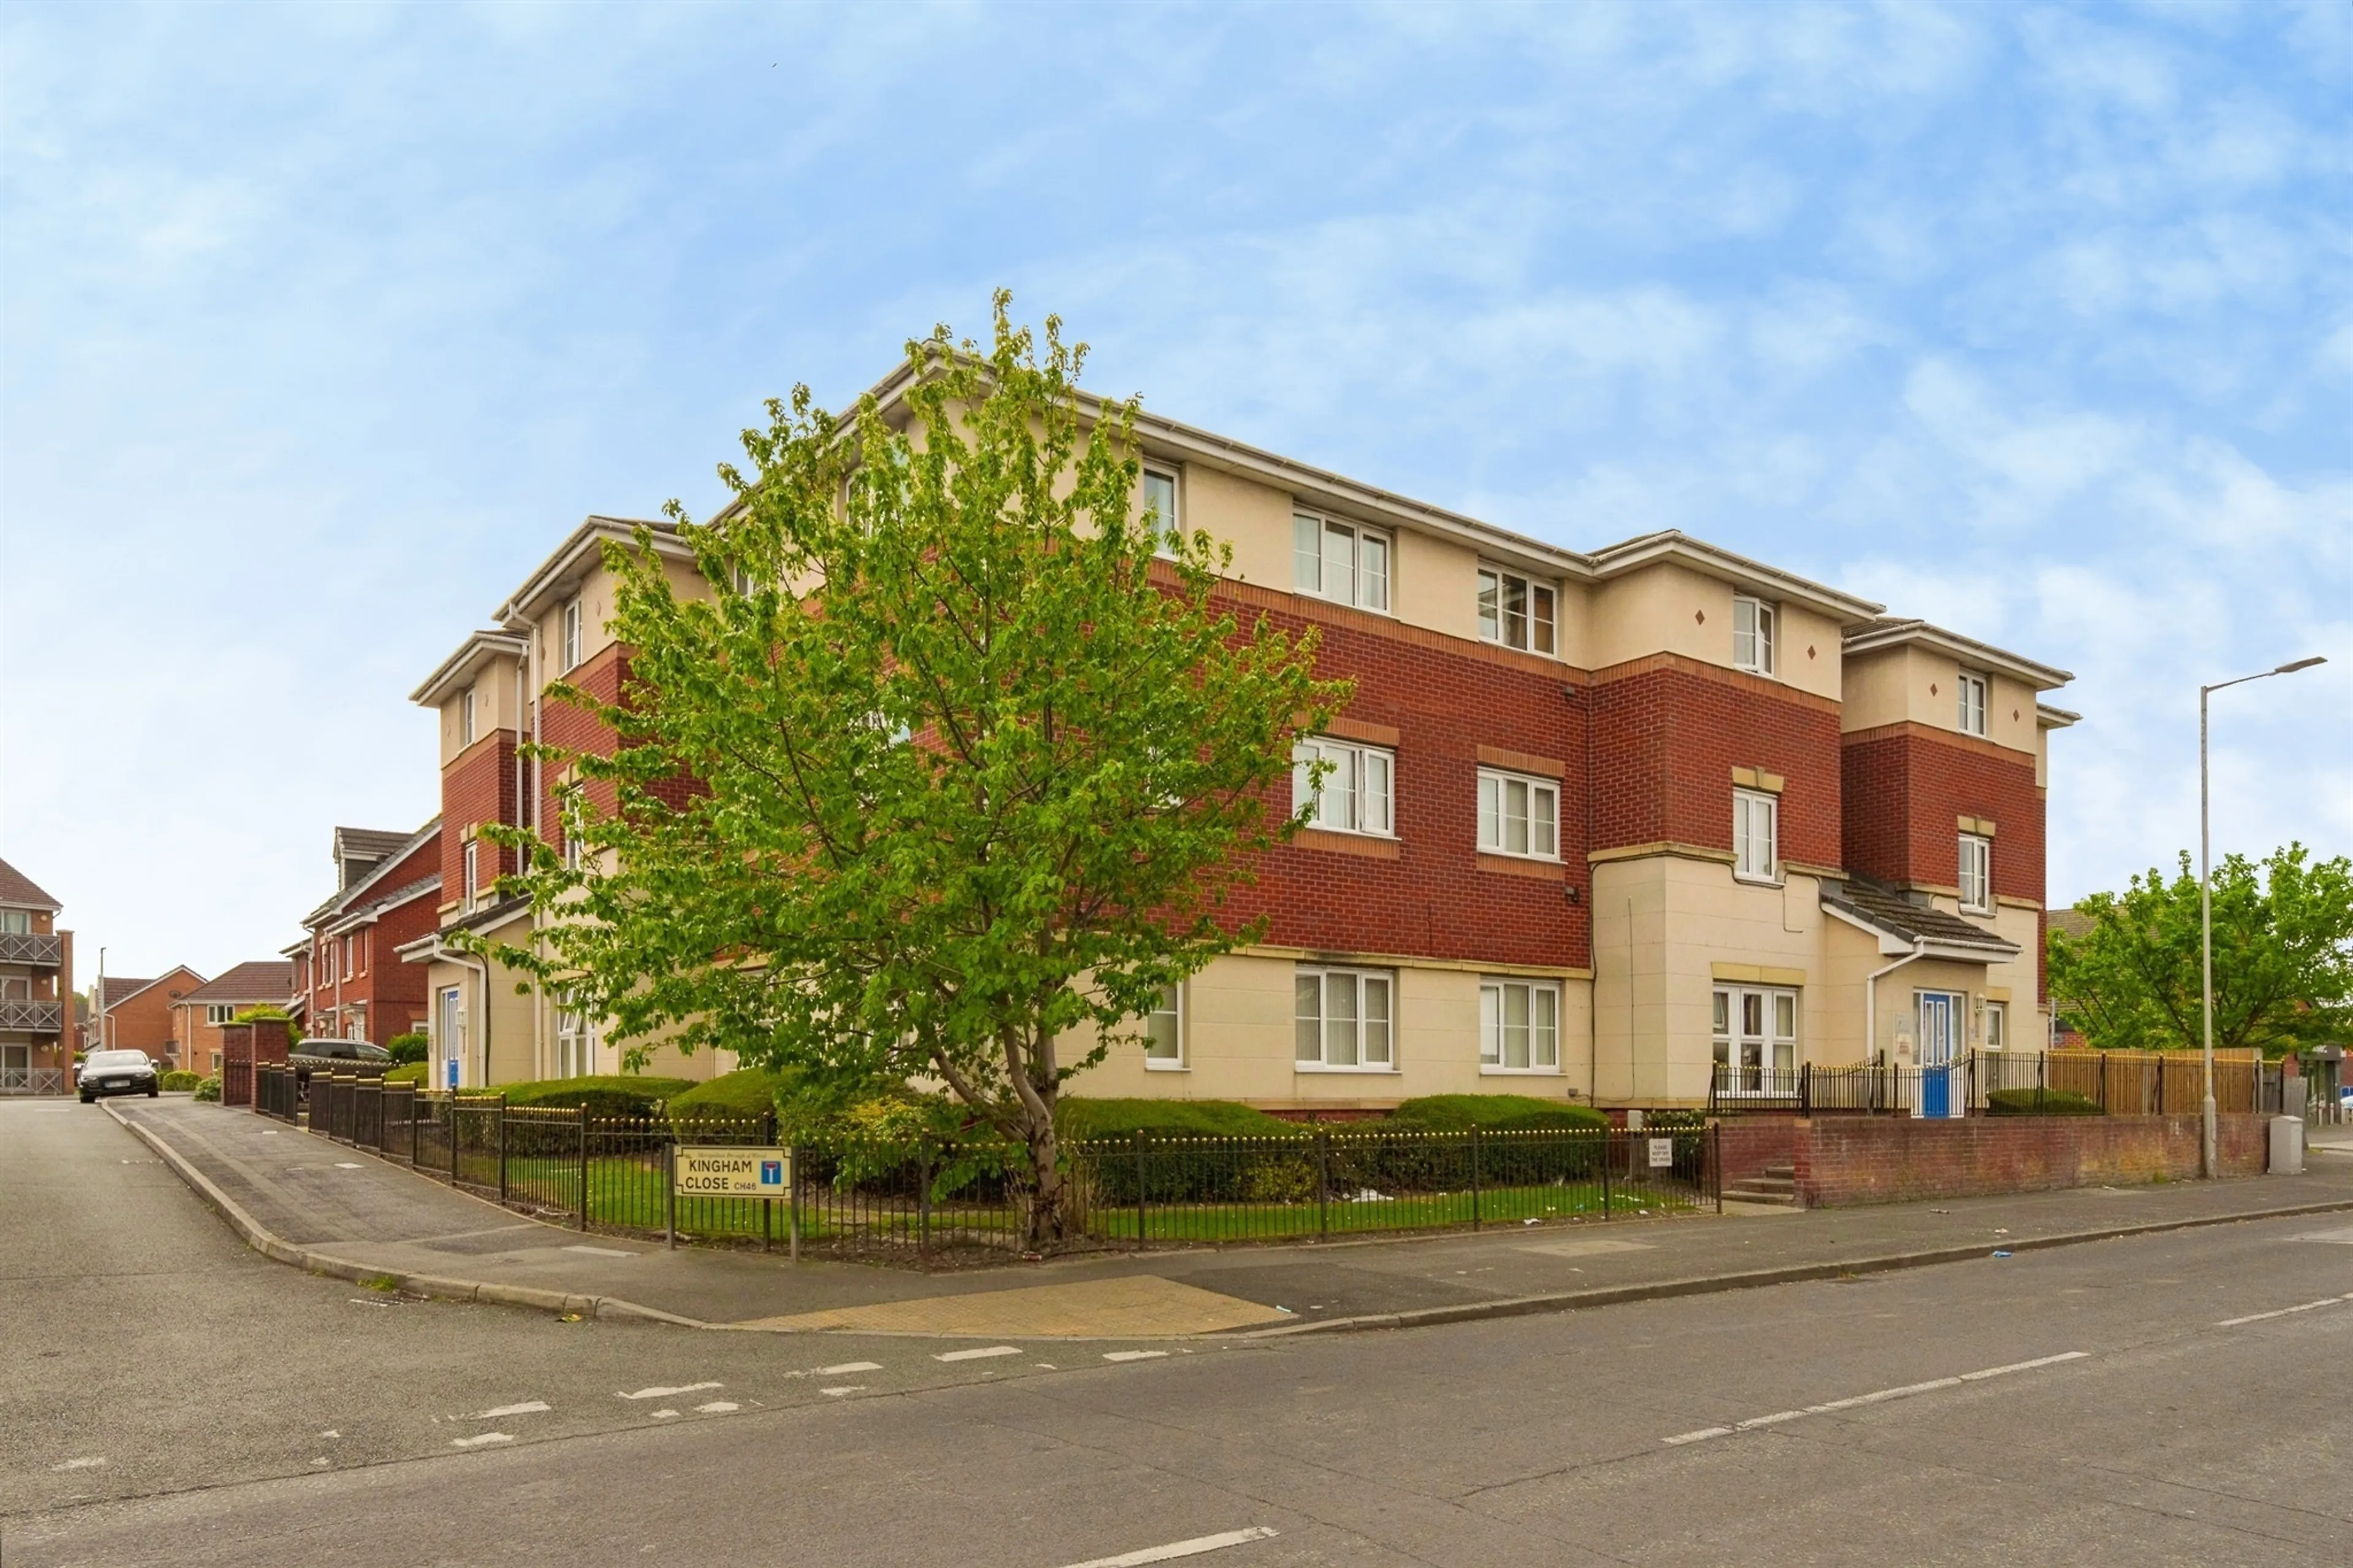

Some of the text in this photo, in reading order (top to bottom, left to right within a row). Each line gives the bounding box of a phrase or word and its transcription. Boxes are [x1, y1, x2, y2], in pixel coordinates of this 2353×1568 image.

[689, 1159, 752, 1173] KINGHAM
[685, 1176, 757, 1191] CLOSE CH46
